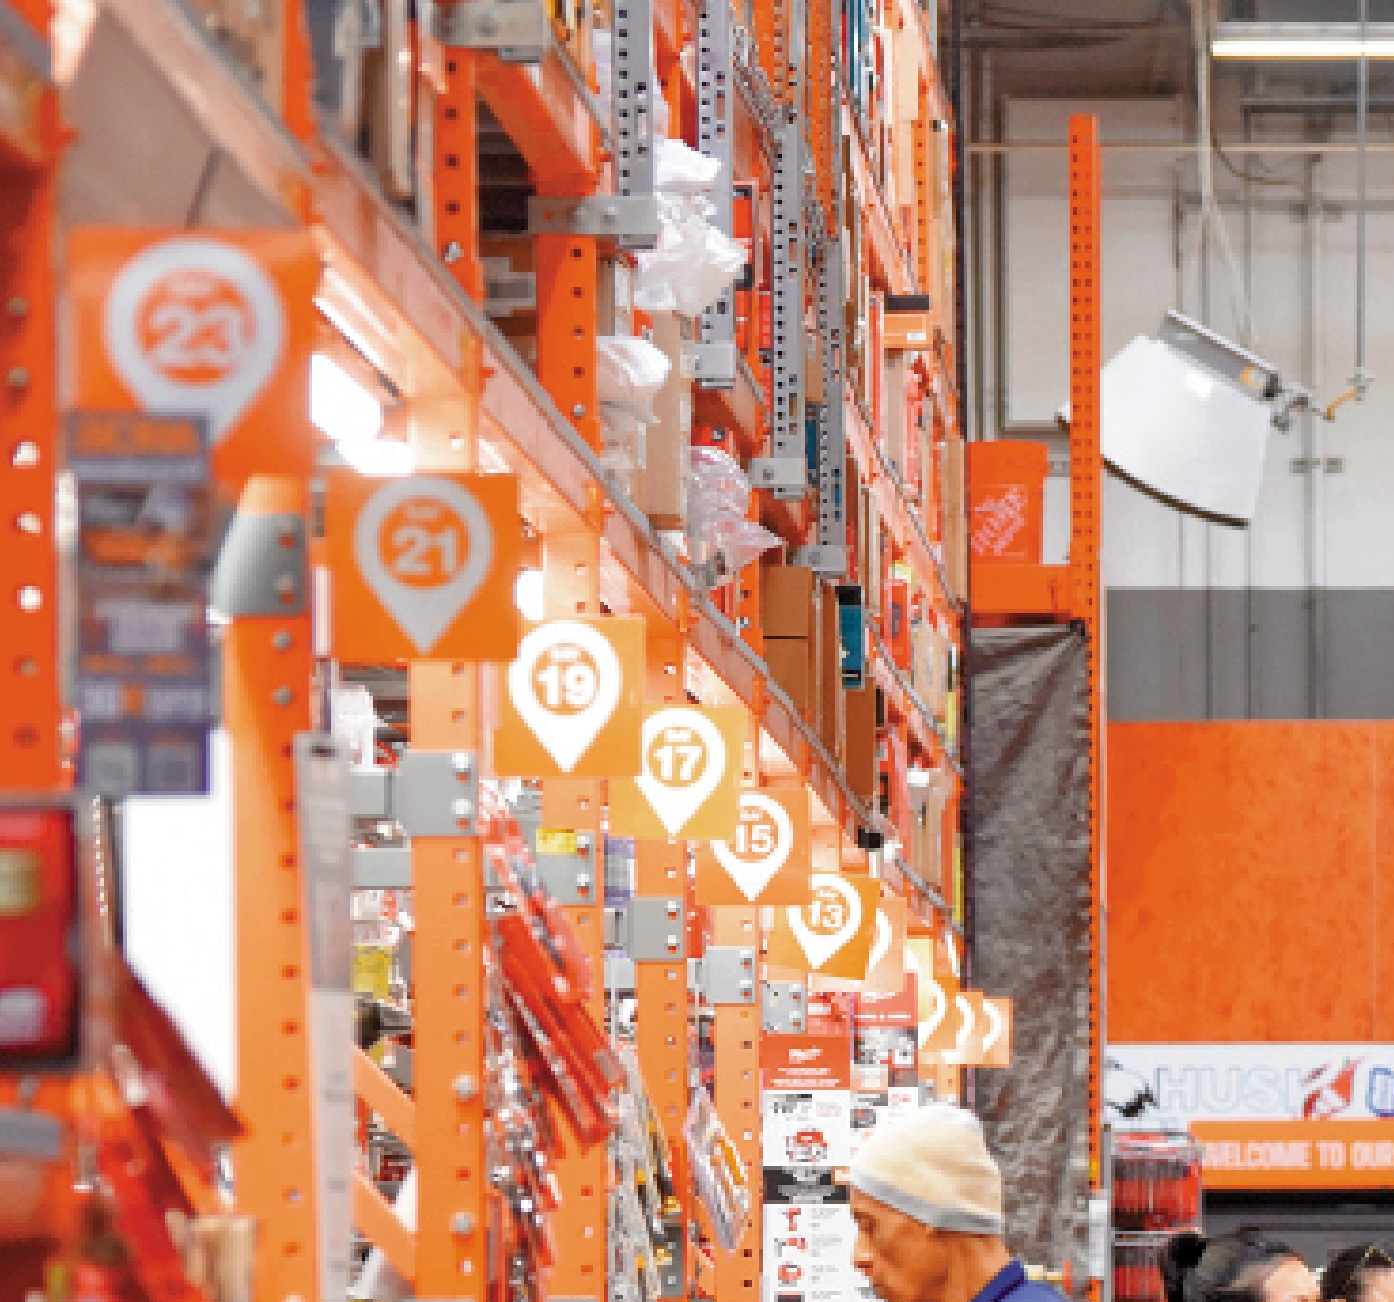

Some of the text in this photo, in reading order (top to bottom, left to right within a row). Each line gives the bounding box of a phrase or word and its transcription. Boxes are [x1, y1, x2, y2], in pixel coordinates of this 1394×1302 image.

[149, 303, 250, 367] 23
[392, 525, 459, 577] 21
[536, 664, 600, 706] 19
[652, 745, 703, 782] 17
[735, 824, 773, 855] 15
[807, 899, 844, 929] 13
[1317, 1140, 1346, 1169] TO
